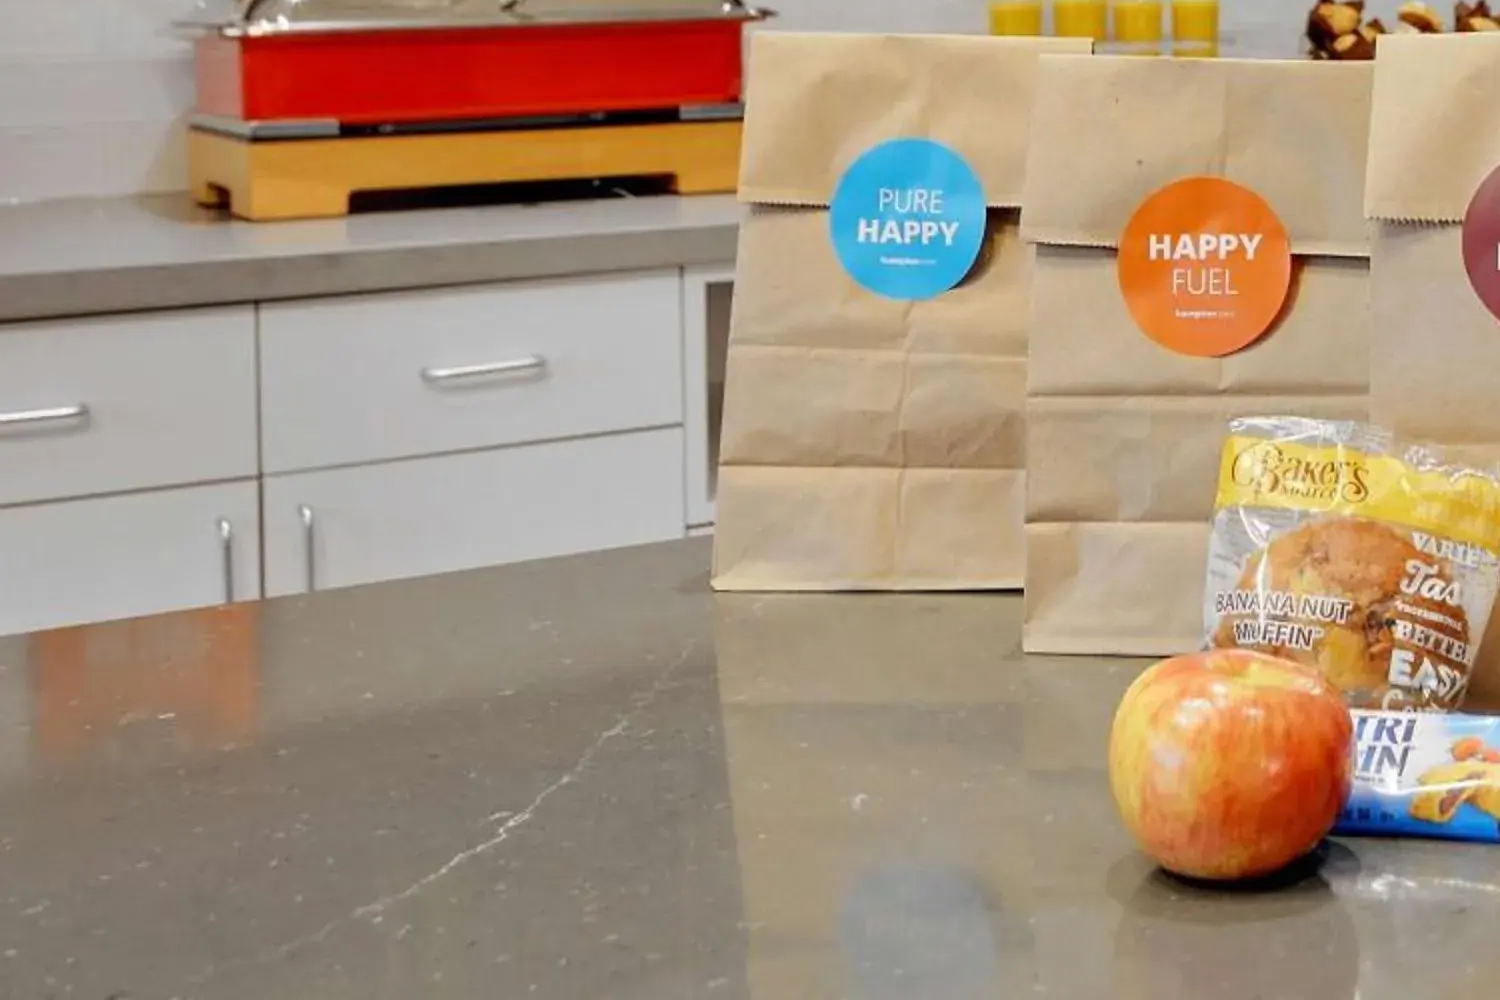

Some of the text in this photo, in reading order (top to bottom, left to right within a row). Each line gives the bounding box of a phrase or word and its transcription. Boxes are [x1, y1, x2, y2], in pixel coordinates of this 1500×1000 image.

[879, 188, 944, 214] PURE
[857, 217, 959, 247] HAPPY
[1149, 233, 1263, 261] HAPPY
[1172, 268, 1240, 295] FUEL
[1411, 530, 1481, 569] VARIE
[1215, 590, 1353, 624] BANANA NUT
[1233, 619, 1315, 650] MUFFIN
[1353, 715, 1416, 745] TRI
[1360, 746, 1410, 777] IN
